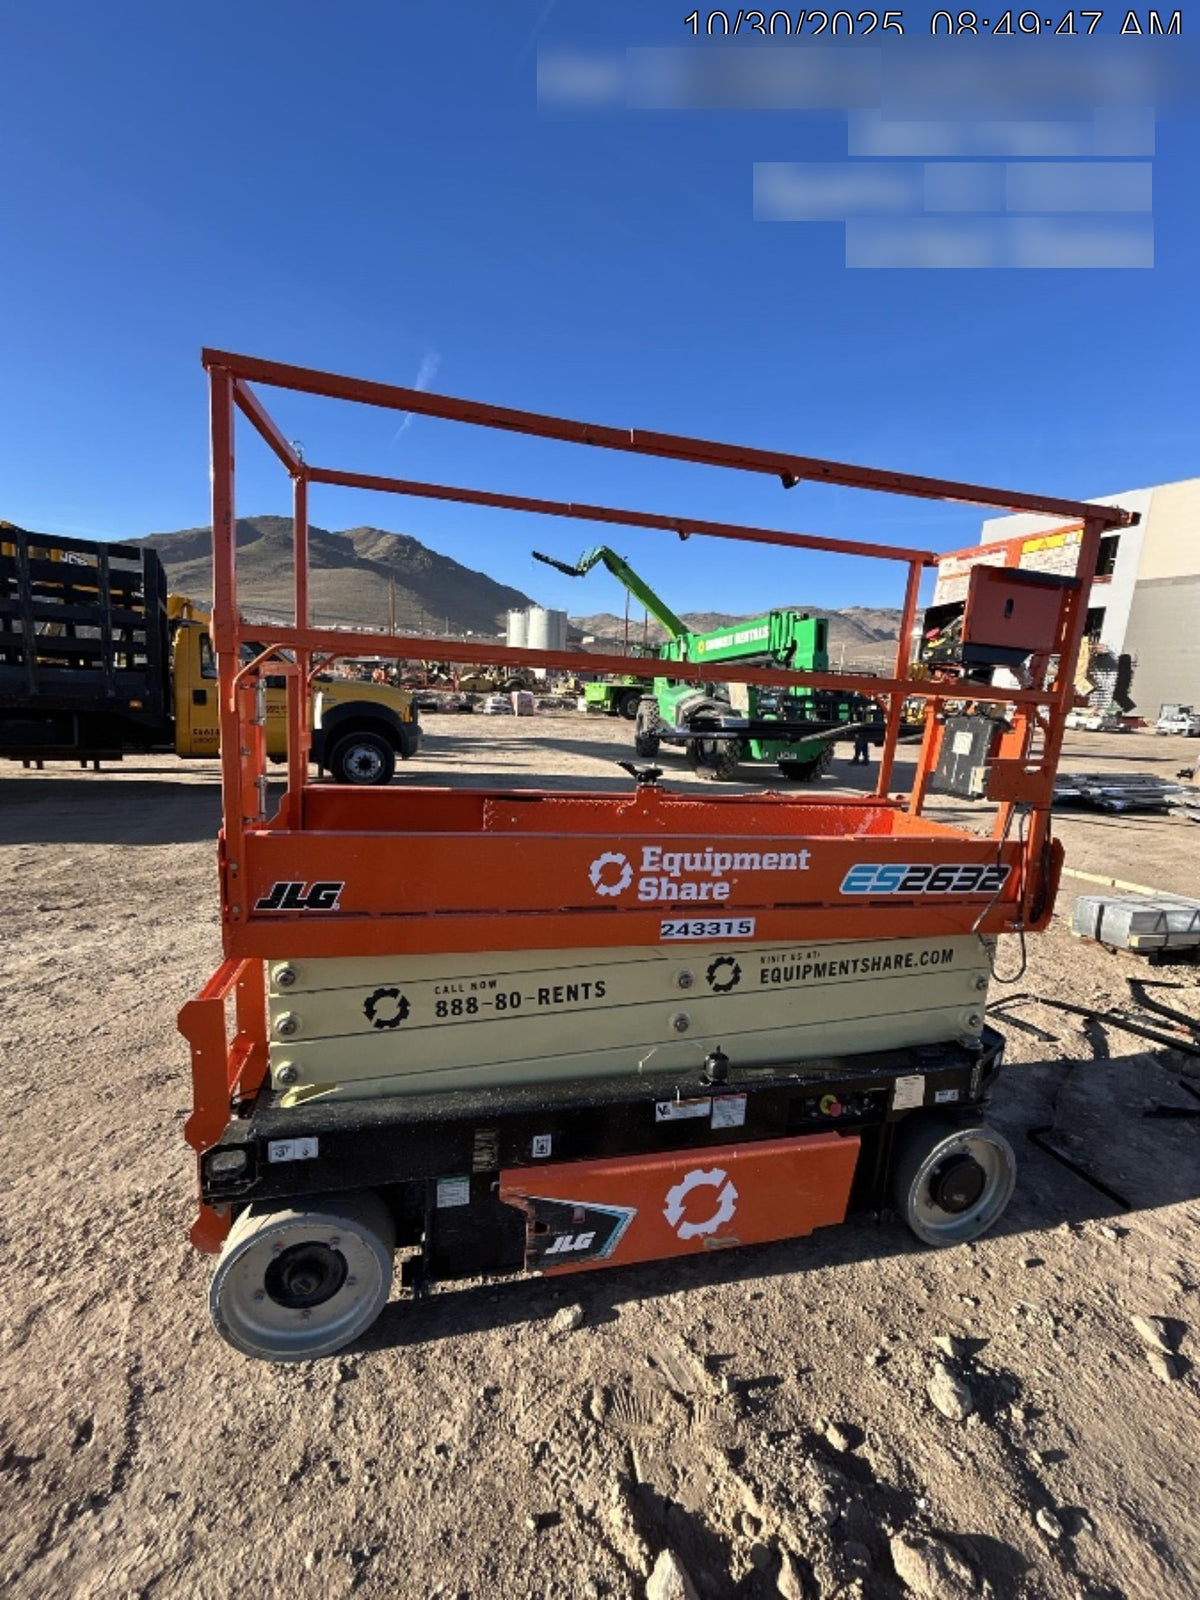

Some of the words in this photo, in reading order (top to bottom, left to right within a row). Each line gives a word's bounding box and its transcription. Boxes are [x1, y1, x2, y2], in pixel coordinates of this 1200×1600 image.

[640, 846, 812, 877] Equipment
[637, 877, 731, 902] Share
[839, 864, 1012, 894] ES2632
[254, 881, 346, 911] JLG
[660, 920, 752, 937] 243315
[760, 948, 954, 984] EQUIPMENTSHARE.COM
[434, 984, 465, 995] CALL
[470, 980, 498, 992] NOW
[435, 980, 607, 1018] 888-80-RENTS
[545, 1231, 596, 1255] JLG
